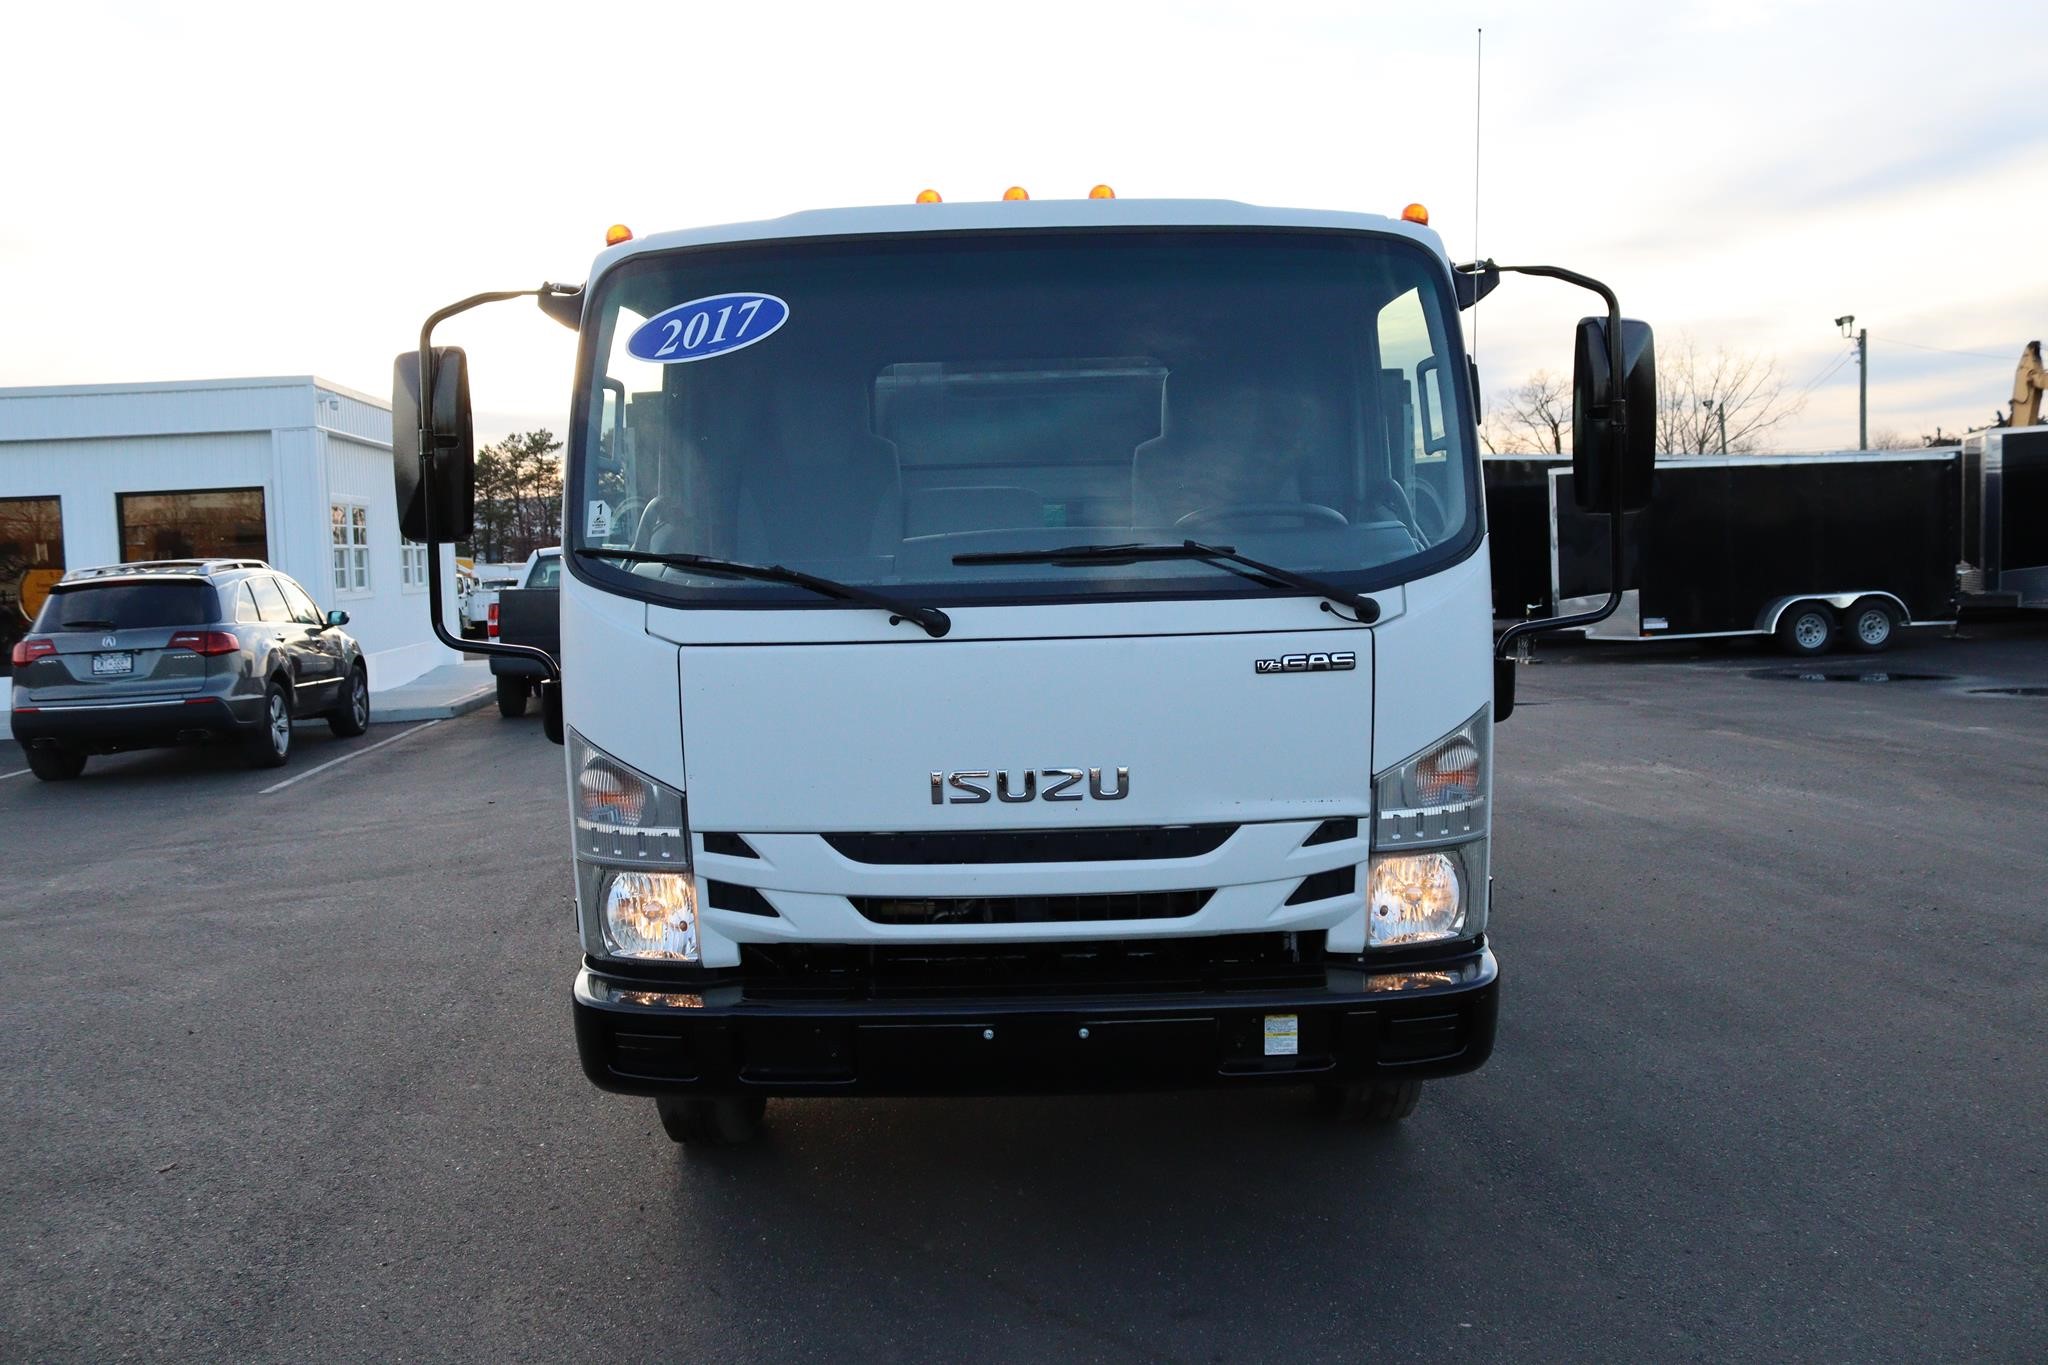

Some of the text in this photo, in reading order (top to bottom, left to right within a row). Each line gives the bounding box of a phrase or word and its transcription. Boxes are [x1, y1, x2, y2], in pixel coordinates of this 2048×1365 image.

[654, 299, 765, 358] 2017
[597, 503, 603, 515] 1
[930, 766, 1130, 805] ISUZU
